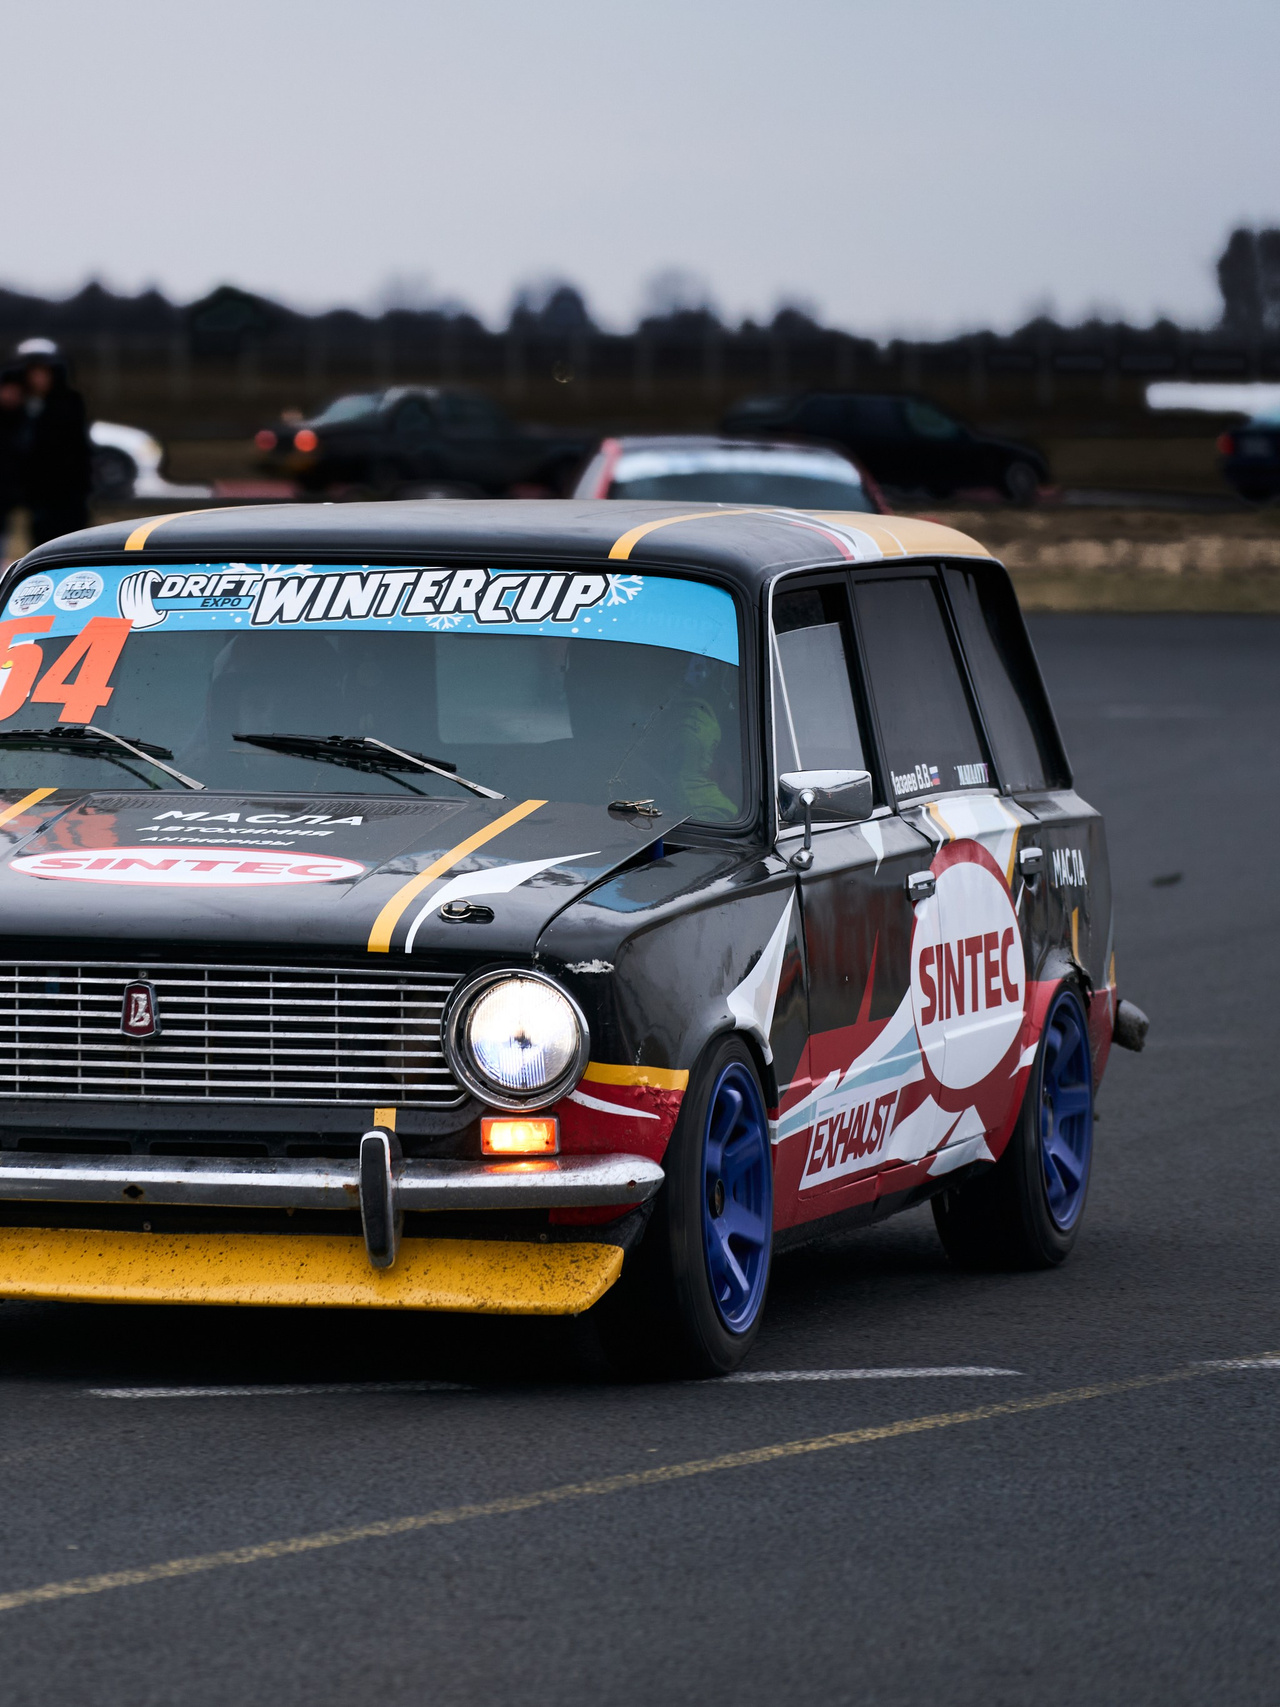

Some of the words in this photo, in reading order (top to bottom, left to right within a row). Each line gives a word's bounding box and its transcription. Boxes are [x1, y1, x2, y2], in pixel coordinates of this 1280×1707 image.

[157, 574, 264, 597] DRIFT
[200, 597, 242, 608] EXPO
[152, 810, 365, 826] МАСЛА
[136, 826, 335, 837] АВТОХИМИЯ
[139, 836, 295, 846] АНТИФРИЗЫ
[31, 858, 345, 877] SINTEC
[1052, 848, 1088, 888] МАСЛА
[919, 926, 1019, 1026] SINTEC
[806, 1089, 898, 1176] EXHAUST
